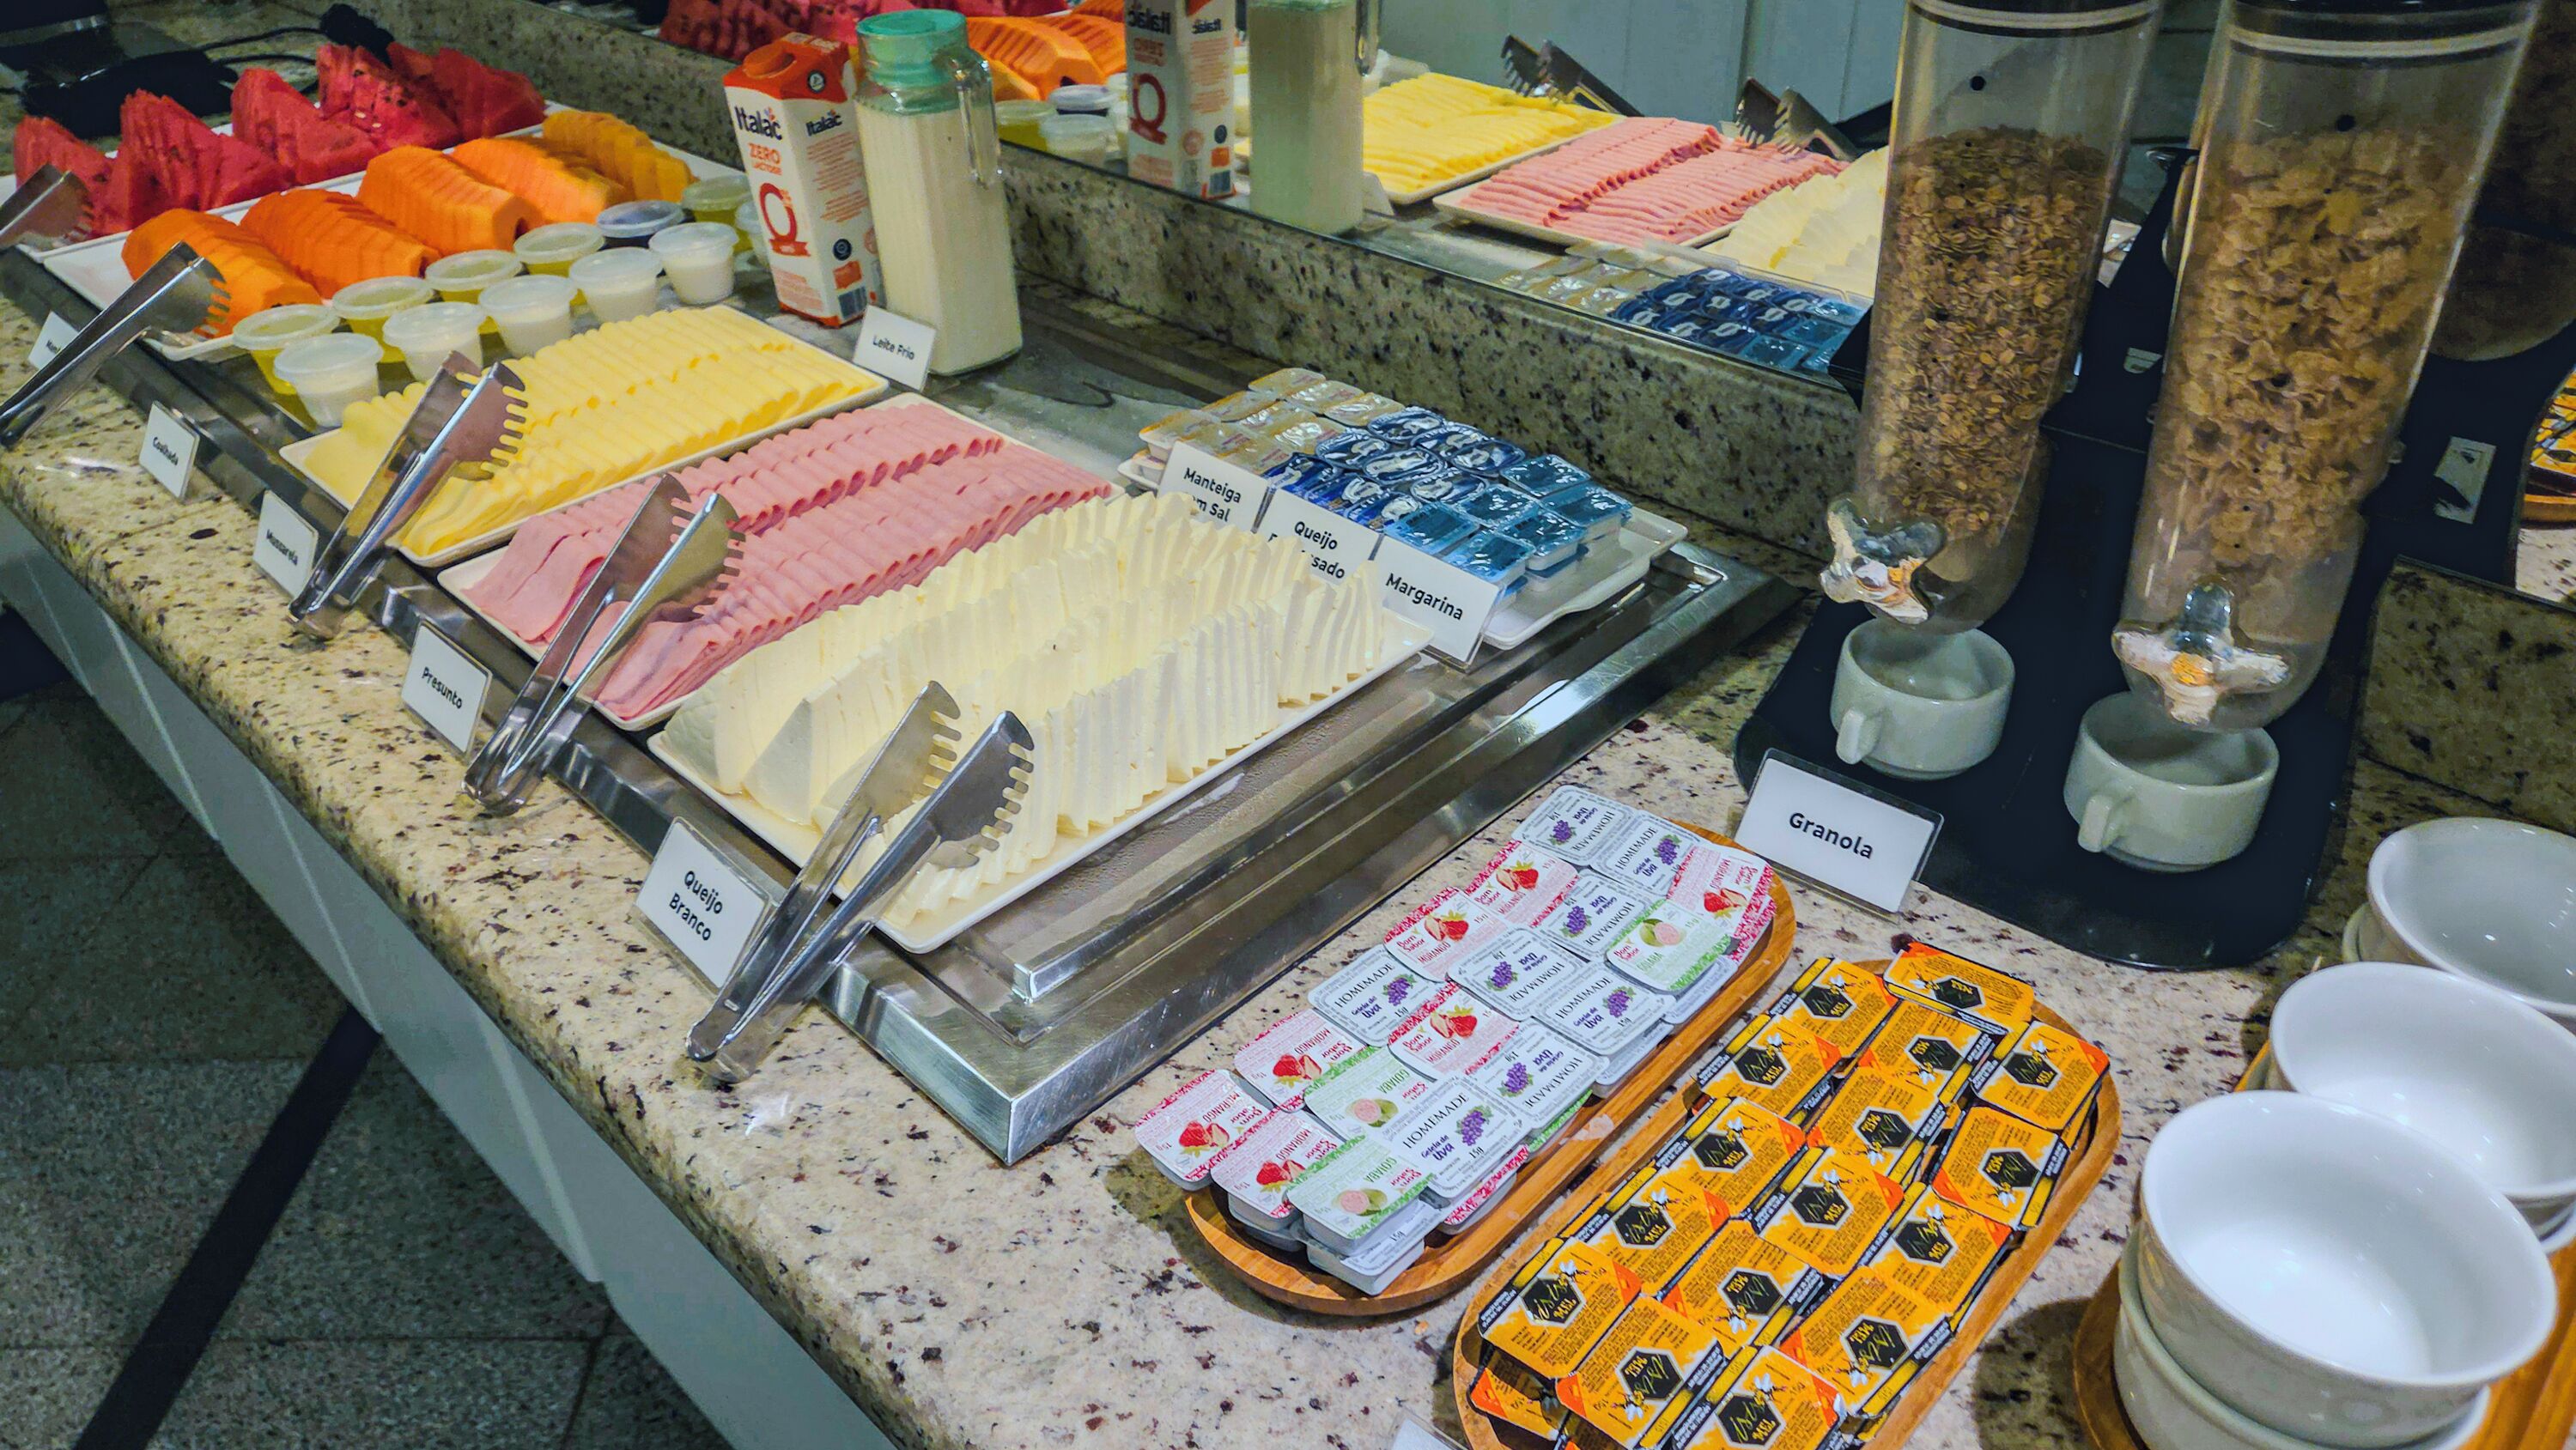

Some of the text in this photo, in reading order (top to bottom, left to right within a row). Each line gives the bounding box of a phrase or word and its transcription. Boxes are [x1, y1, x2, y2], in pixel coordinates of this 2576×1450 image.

[735, 106, 782, 140] Italac
[872, 335, 914, 360] Leite Frio
[1183, 467, 1242, 503] Manteiga
[1209, 502, 1230, 522] Sal
[1294, 521, 1338, 549] Queijo
[1385, 572, 1463, 621] Margarina
[422, 666, 463, 709] Presunto
[1572, 807, 1589, 820] Uva
[1572, 812, 1615, 852] HOMEMADE
[1789, 812, 1874, 859] Granola
[1614, 827, 1658, 871] HOMEMADE
[1642, 863, 1658, 877] Uva
[1710, 858, 1731, 889] MORANGO
[683, 870, 724, 915] Queijo
[1498, 890, 1526, 915] MORANGO
[1589, 895, 1607, 909] Uva
[669, 893, 712, 942] Branco
[1585, 901, 1635, 947] HOMEMADE
[1416, 942, 1451, 964] MORANGO
[1517, 952, 1537, 966] Uva
[1636, 952, 1663, 971] GOIABA
[1334, 963, 1395, 1009] HOMEMADE
[1509, 962, 1565, 1003] HOMEMADE
[1555, 978, 1613, 1019] HOMEMADE
[1361, 1004, 1382, 1021] Uva
[1583, 1014, 1605, 1029] Uva
[1294, 1028, 1331, 1055] MORANGO
[1427, 1039, 1461, 1064] MORANGO
[1532, 1047, 1553, 1066] Uva
[1376, 1069, 1410, 1094] GOIABA
[1524, 1057, 1583, 1107] HOMEMADE
[1230, 1107, 1249, 1125] abor
[1402, 1093, 1470, 1149] HOMEMADE
[1432, 1143, 1455, 1162] Uva
[1553, 1297, 1577, 1320] MEL
[1850, 1322, 1874, 1344] MEL
[1625, 1356, 1648, 1378] MEL
[1752, 1418, 1776, 1441] MEL
